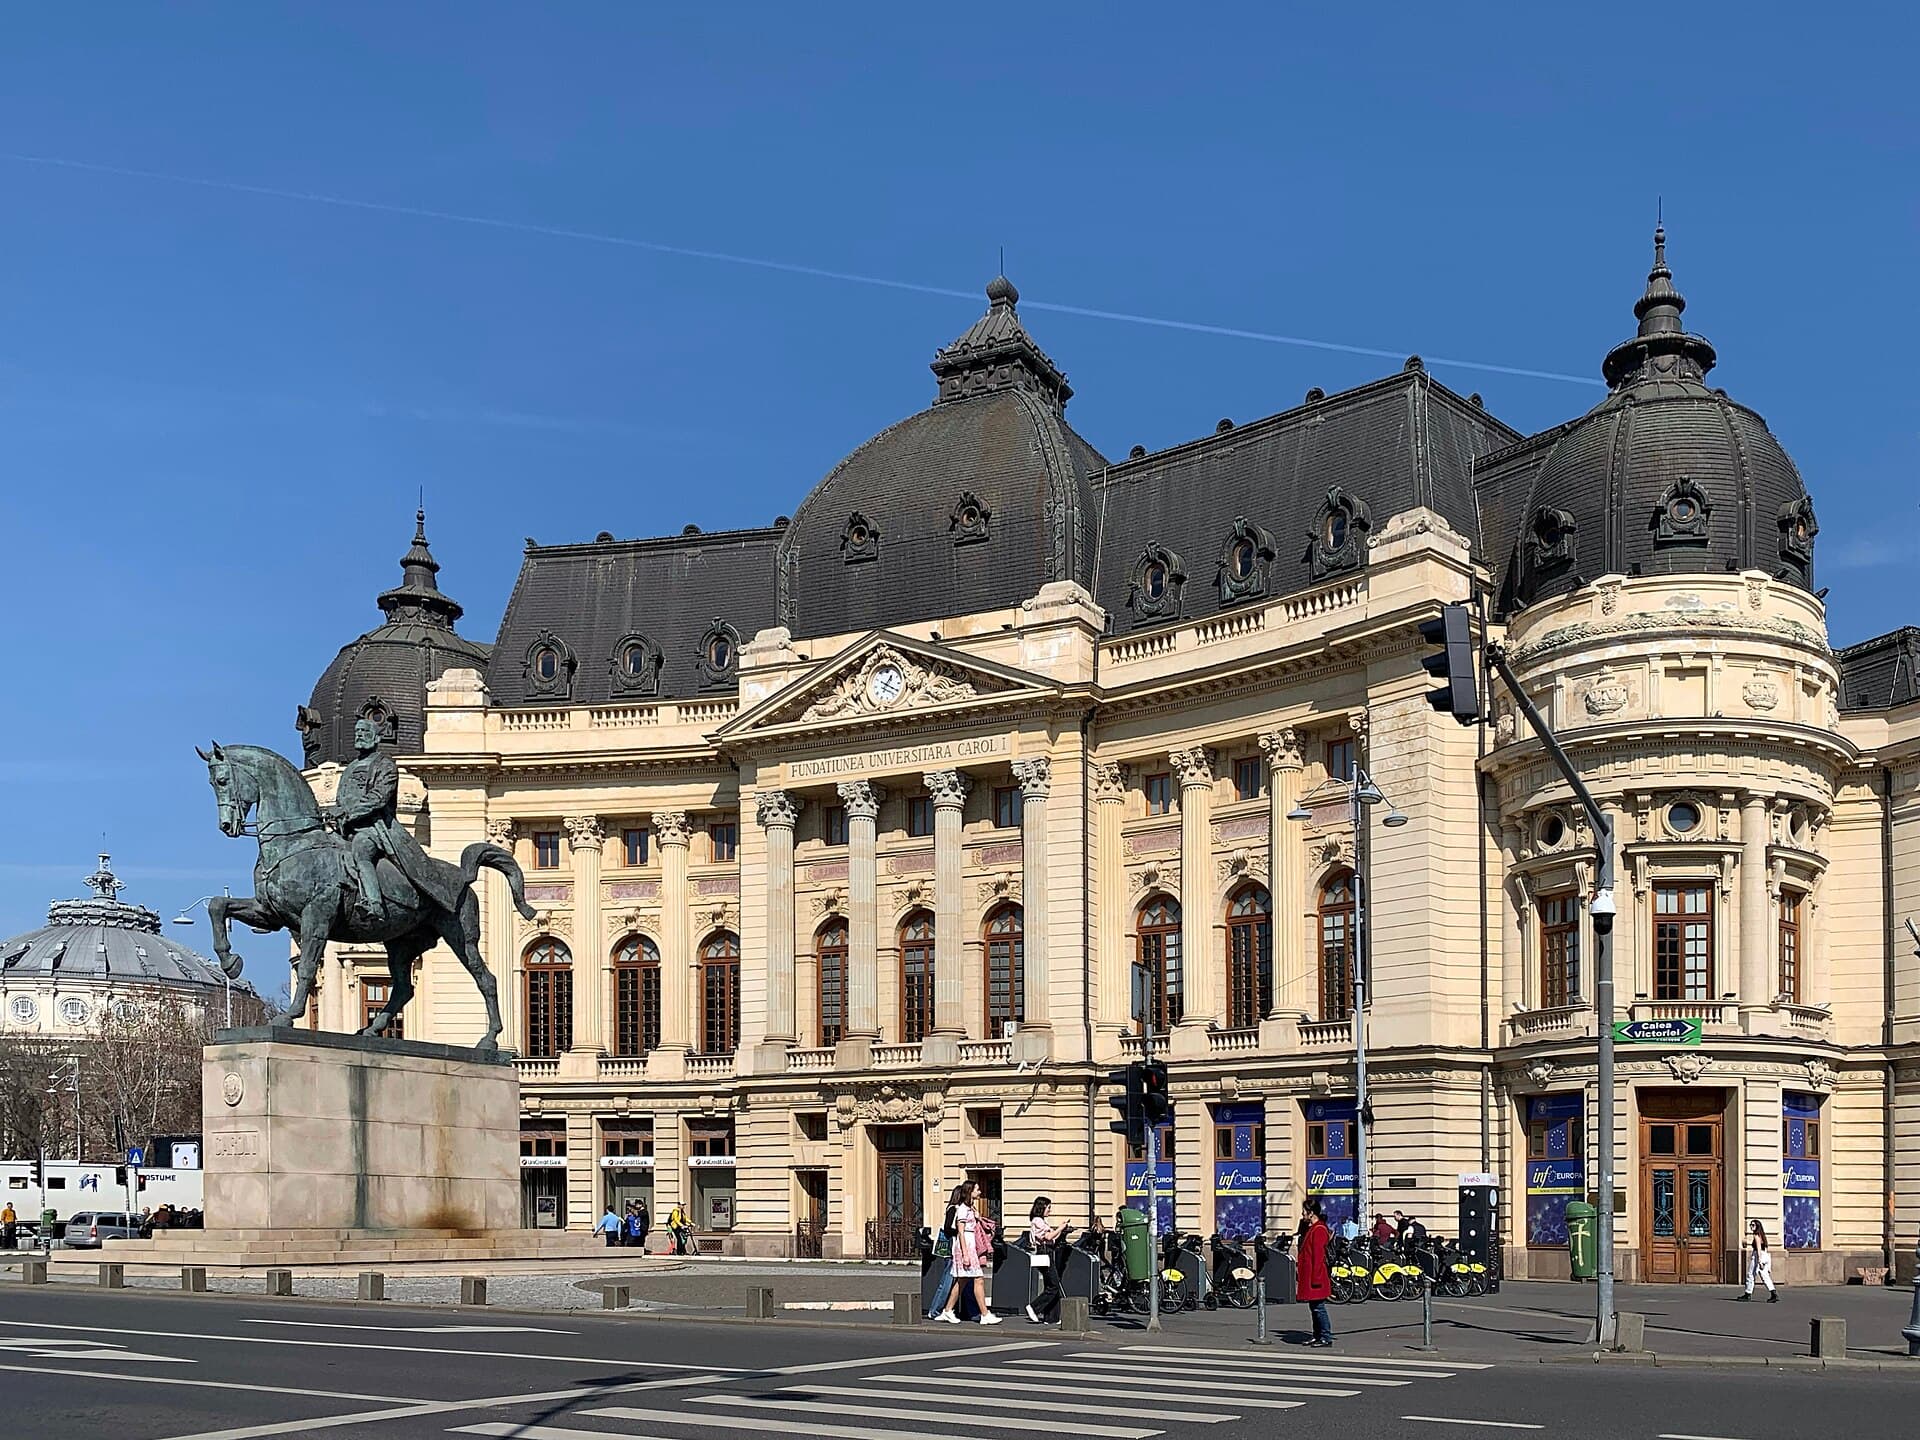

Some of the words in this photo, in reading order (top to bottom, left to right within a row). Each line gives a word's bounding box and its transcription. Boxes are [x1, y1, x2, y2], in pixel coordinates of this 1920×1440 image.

[791, 756, 865, 777] FUNDATIUNEA
[869, 745, 952, 768] UNIVERSITARA
[957, 740, 997, 756] CAROL
[1002, 737, 1006, 750] I
[1641, 1022, 1672, 1030] Calea
[1634, 1029, 1680, 1038] Victoriei
[145, 1173, 176, 1182] OSTUME
